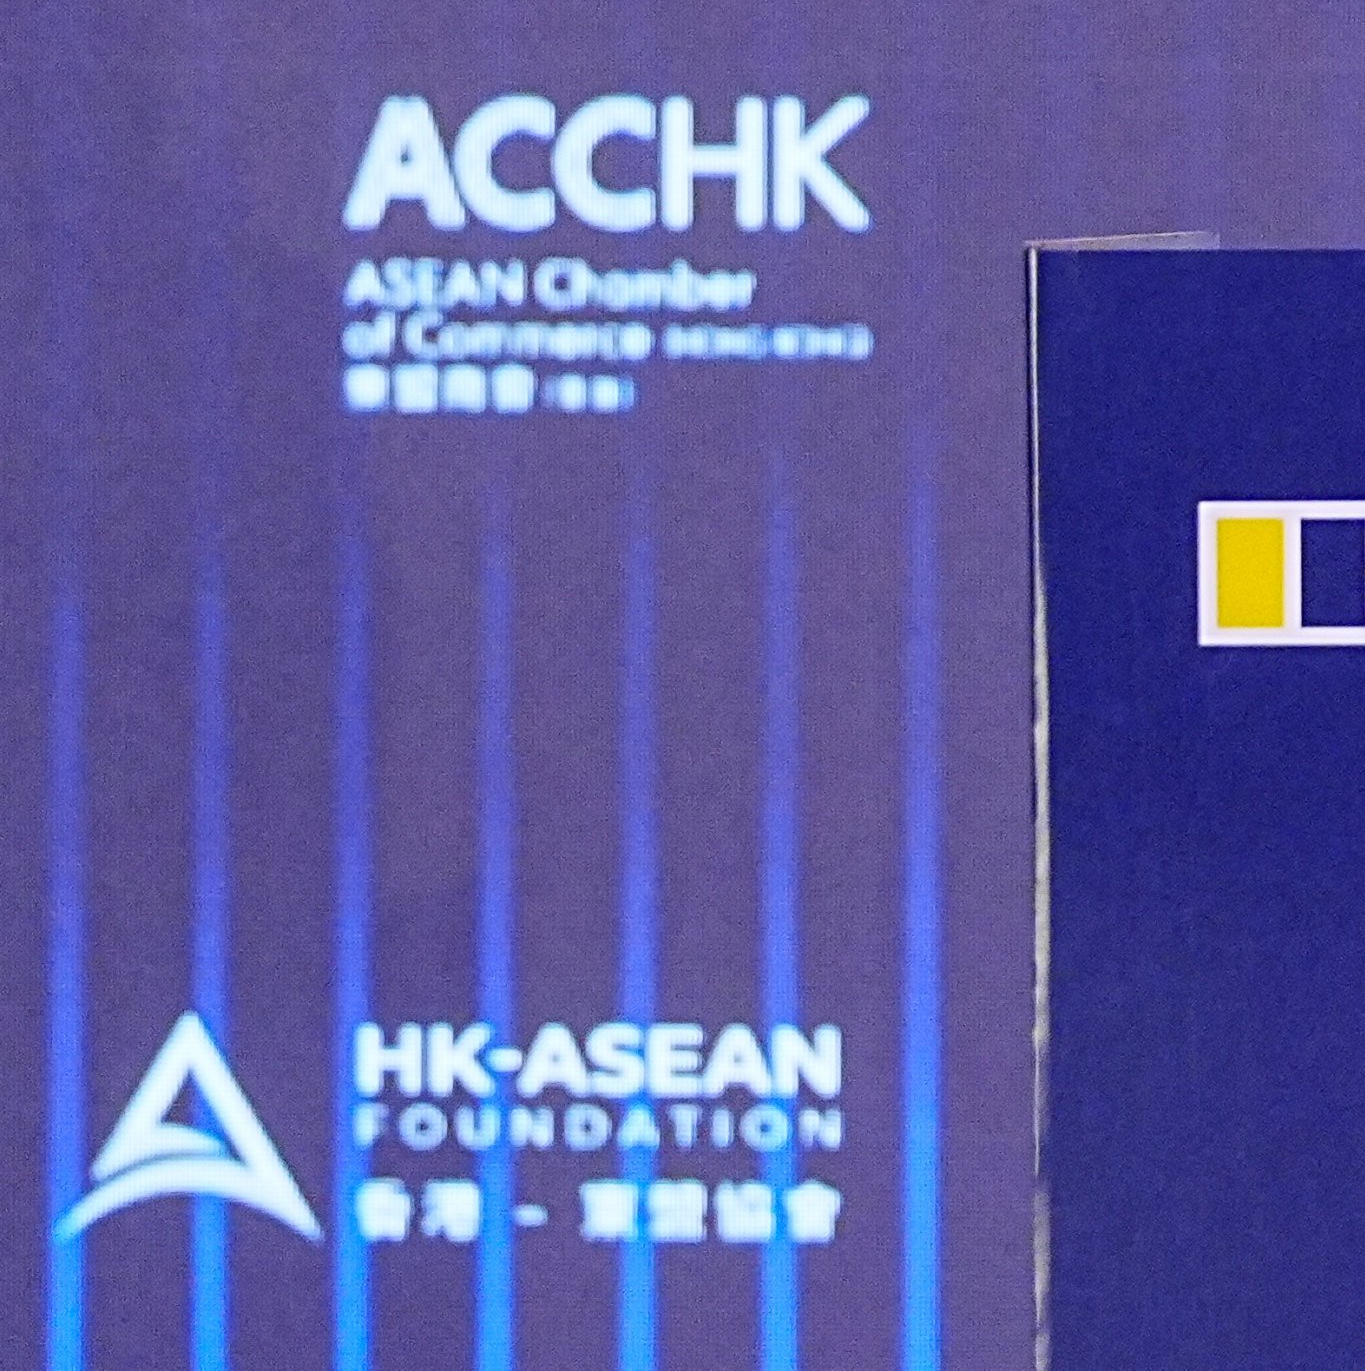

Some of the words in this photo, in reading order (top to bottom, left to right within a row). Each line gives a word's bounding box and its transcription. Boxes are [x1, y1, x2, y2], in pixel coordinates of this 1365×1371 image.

[344, 97, 869, 231] ACCHK
[357, 1024, 841, 1097] HK-ASEAN
[357, 1105, 842, 1148] FOUNDATION
